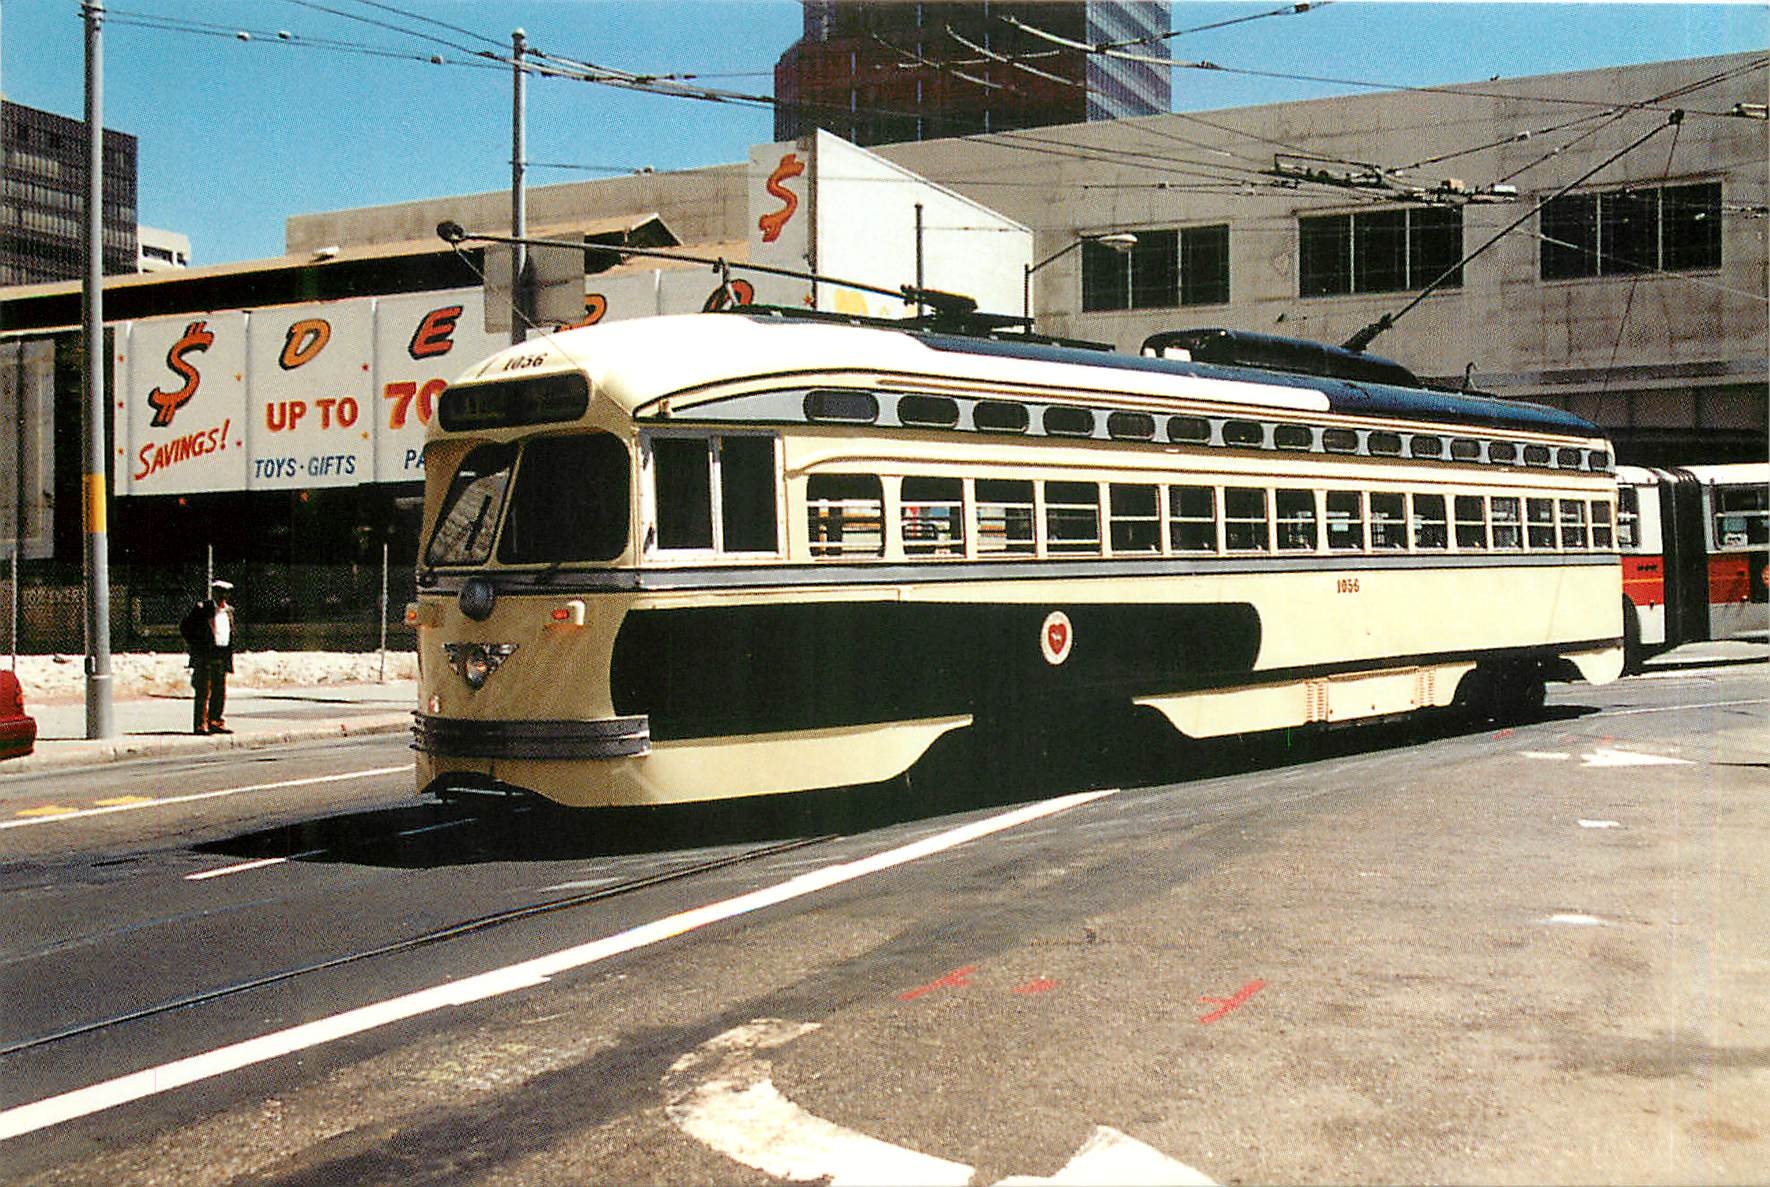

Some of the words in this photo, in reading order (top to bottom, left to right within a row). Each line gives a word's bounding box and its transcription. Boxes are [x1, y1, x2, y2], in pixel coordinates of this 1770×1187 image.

[502, 352, 549, 372] 1056
[265, 400, 307, 433] UP
[315, 396, 360, 430] TO
[134, 418, 232, 481] SAVINGS!
[254, 457, 297, 479] TOYS
[307, 454, 356, 477] GIFTS
[1336, 577, 1361, 594] 1056
